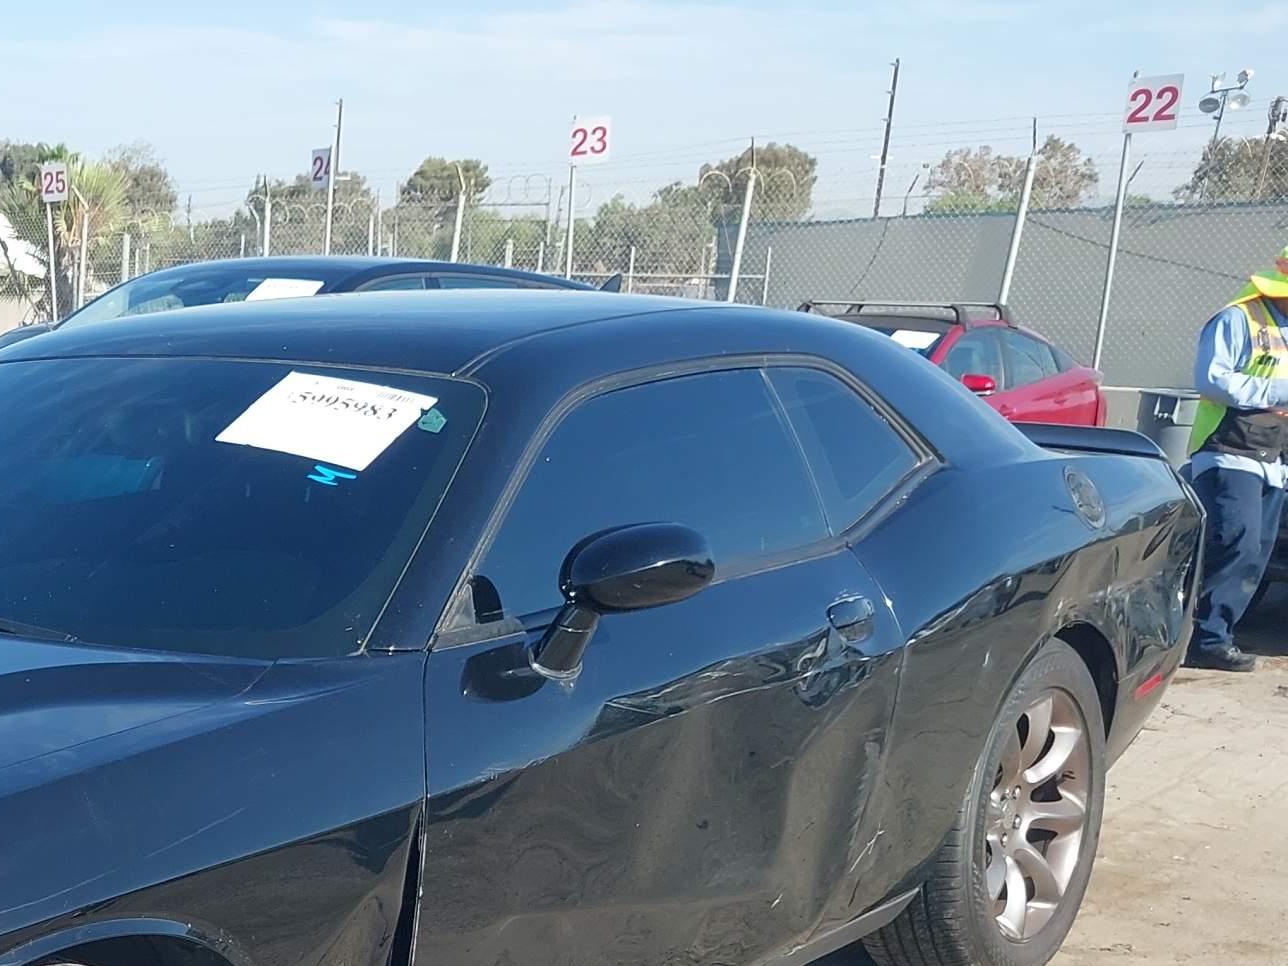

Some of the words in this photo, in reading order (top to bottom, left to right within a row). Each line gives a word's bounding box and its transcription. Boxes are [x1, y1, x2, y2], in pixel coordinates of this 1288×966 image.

[1126, 86, 1179, 124] 22
[571, 126, 607, 157] 23
[43, 170, 66, 195] 25
